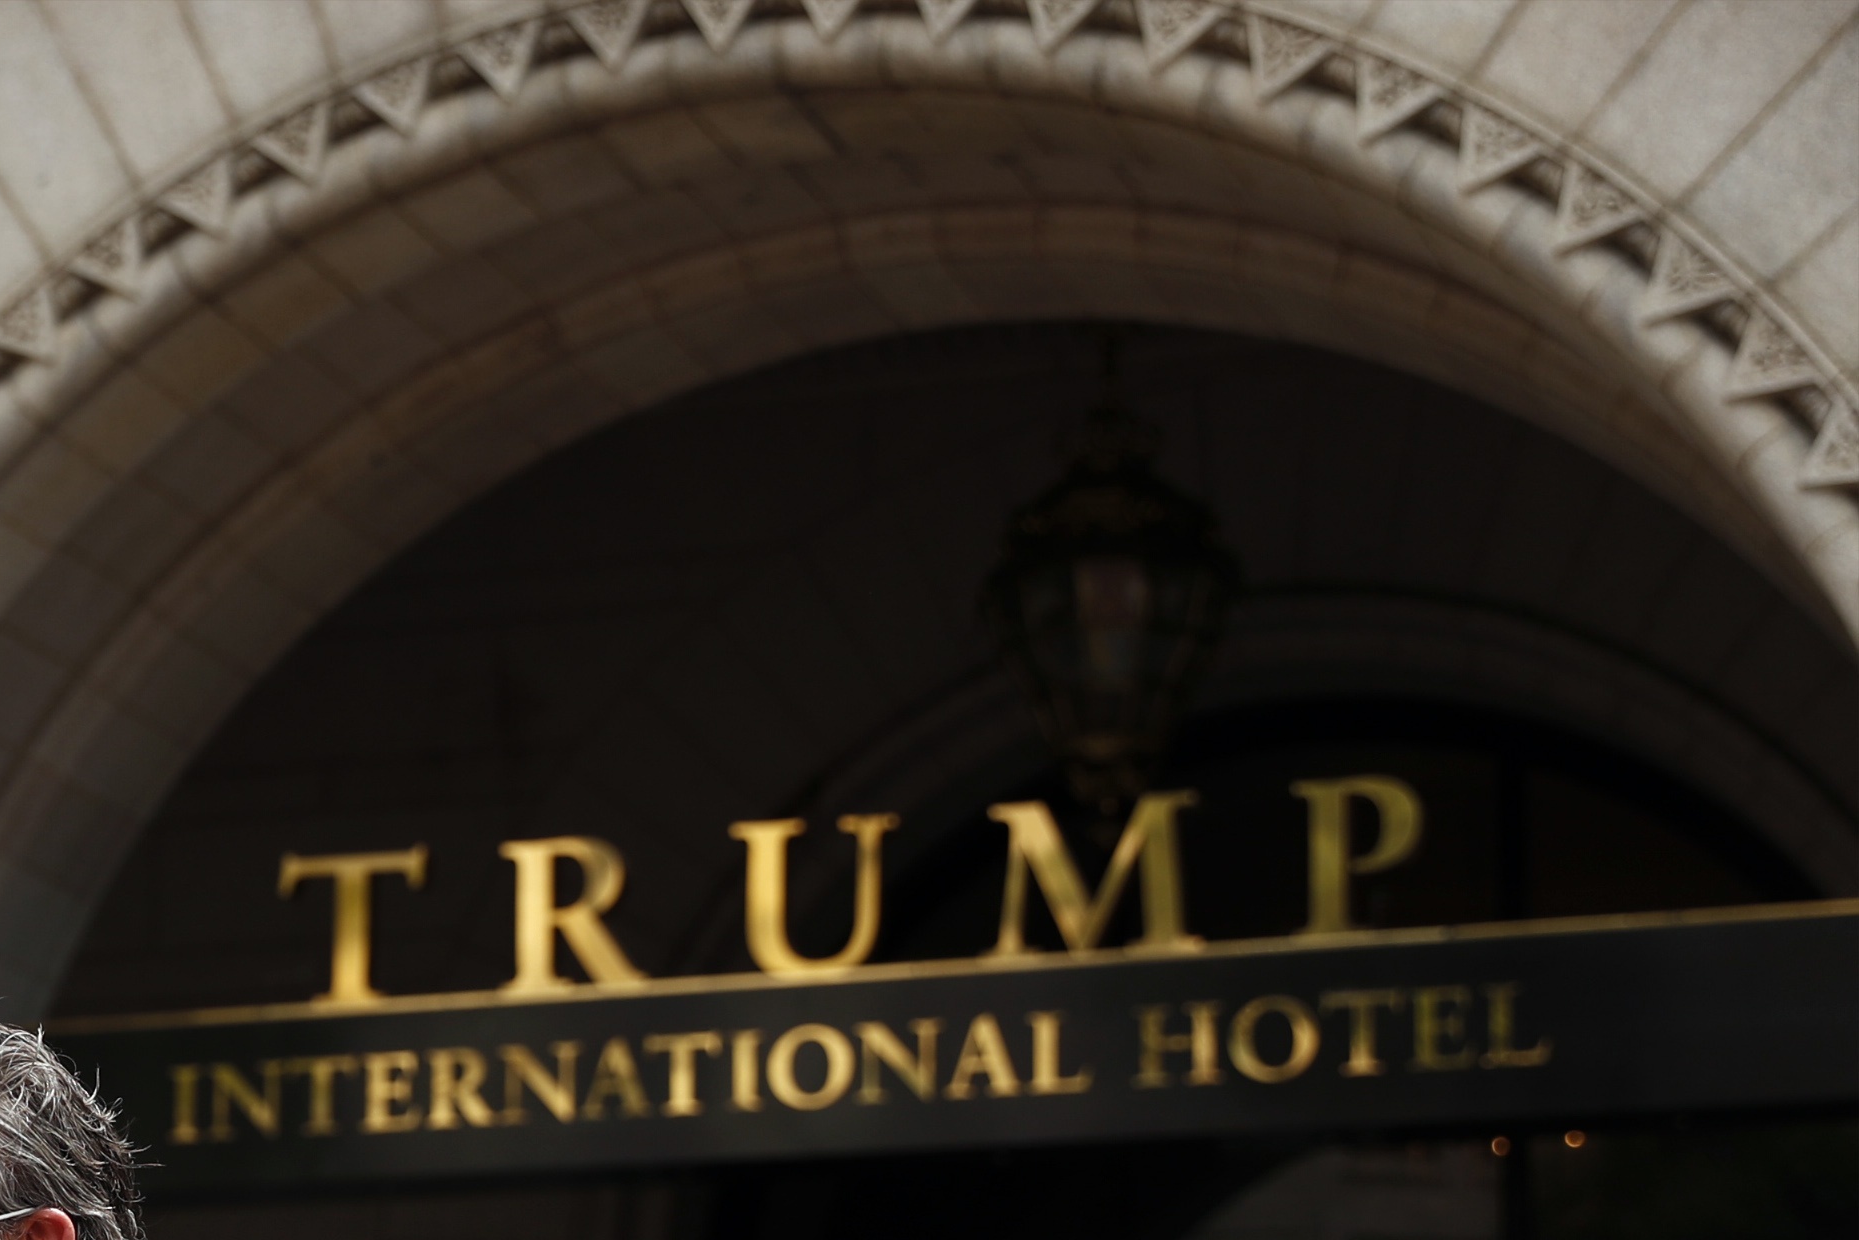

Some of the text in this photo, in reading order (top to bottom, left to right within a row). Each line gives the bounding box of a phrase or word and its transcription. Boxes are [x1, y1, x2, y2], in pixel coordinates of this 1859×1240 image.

[279, 773, 1425, 1005] TRUMP
[168, 982, 1553, 1145] INTERNATIONAL HOTEL
